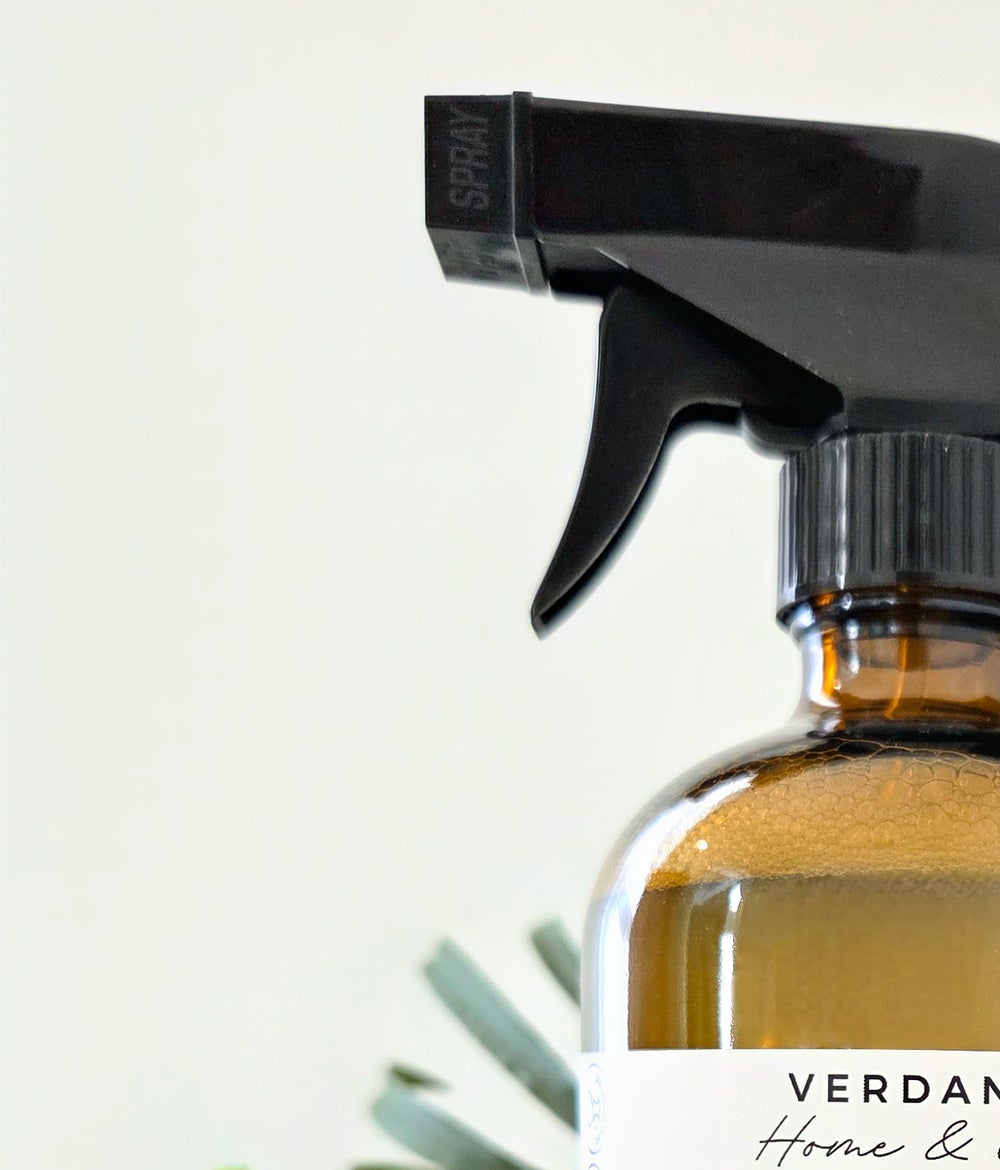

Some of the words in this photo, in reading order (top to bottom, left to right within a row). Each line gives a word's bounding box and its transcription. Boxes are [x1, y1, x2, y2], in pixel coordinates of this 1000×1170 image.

[450, 105, 489, 210] SPRAY
[755, 1115, 905, 1167] Home
[925, 1120, 973, 1160] &
